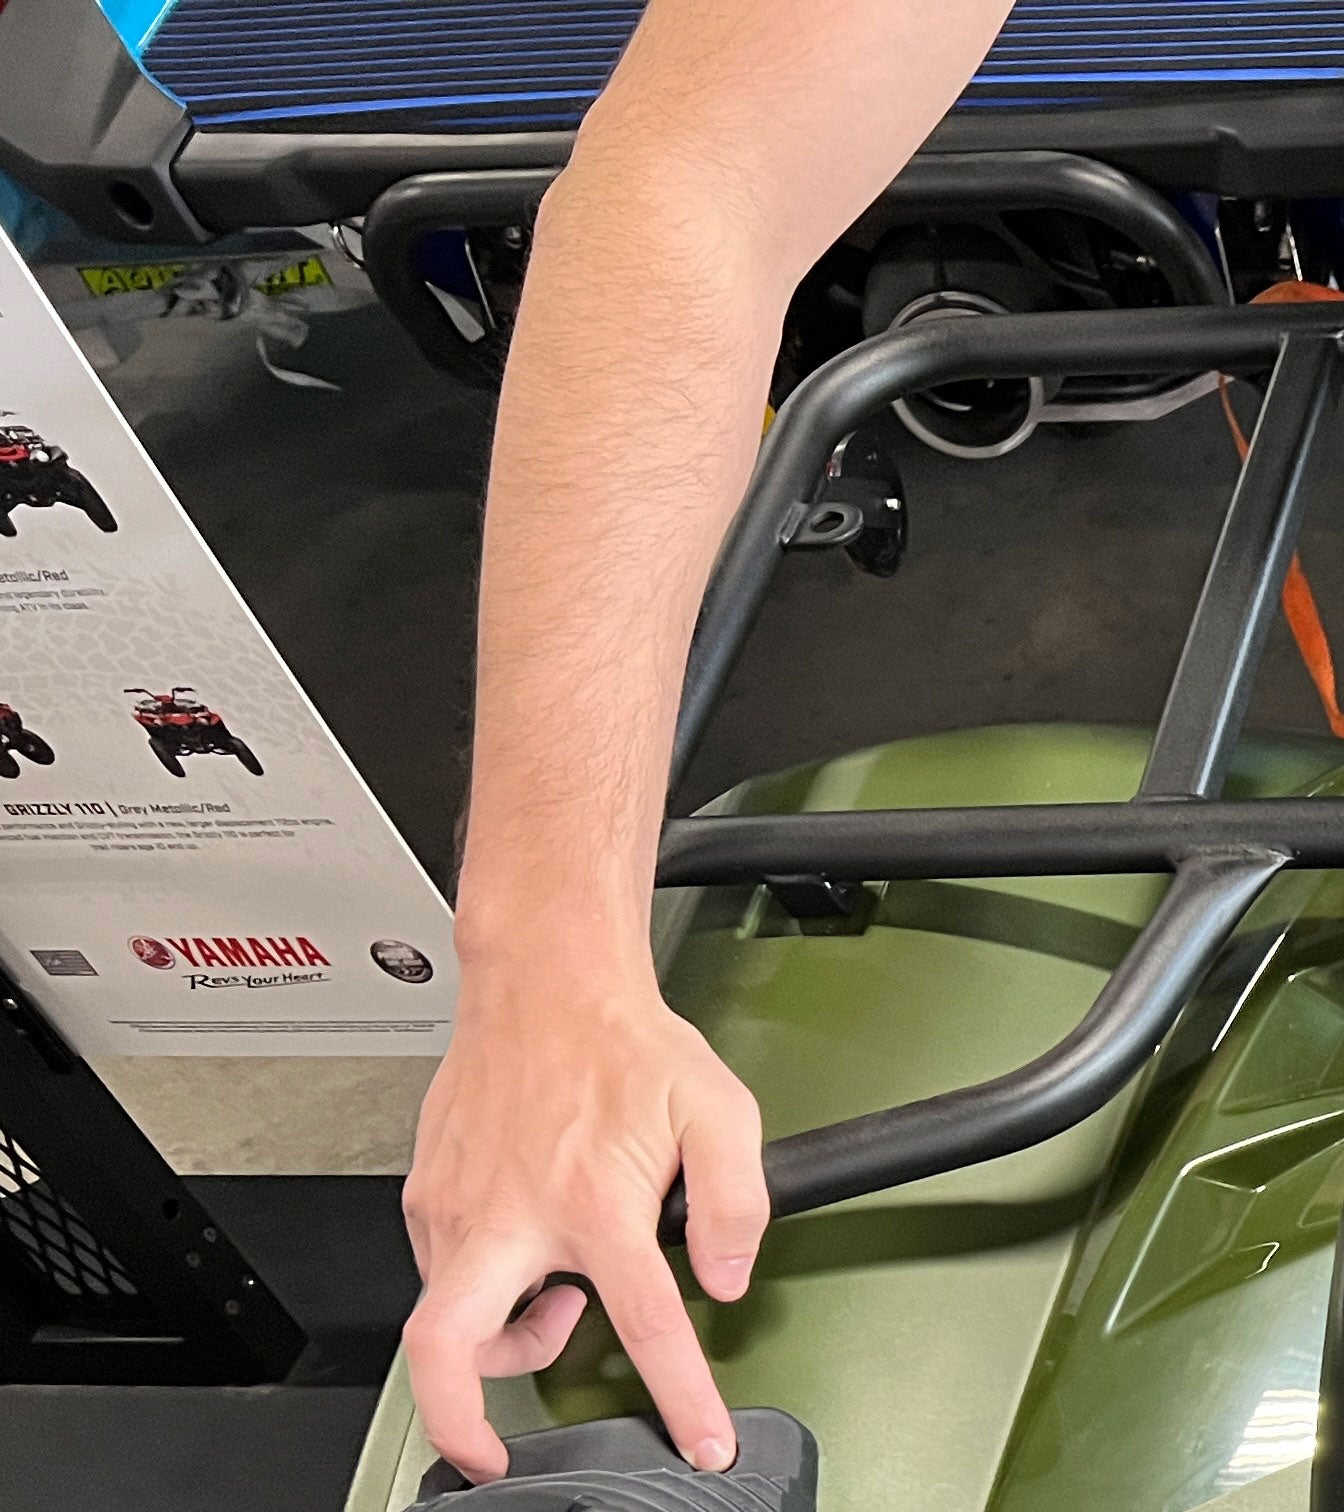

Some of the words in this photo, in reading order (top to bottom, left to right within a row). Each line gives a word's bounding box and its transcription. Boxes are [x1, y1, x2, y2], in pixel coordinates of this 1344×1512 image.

[3, 803, 72, 815] GRIZZLY
[75, 803, 105, 815] 110
[164, 936, 331, 967] YAMAHA
